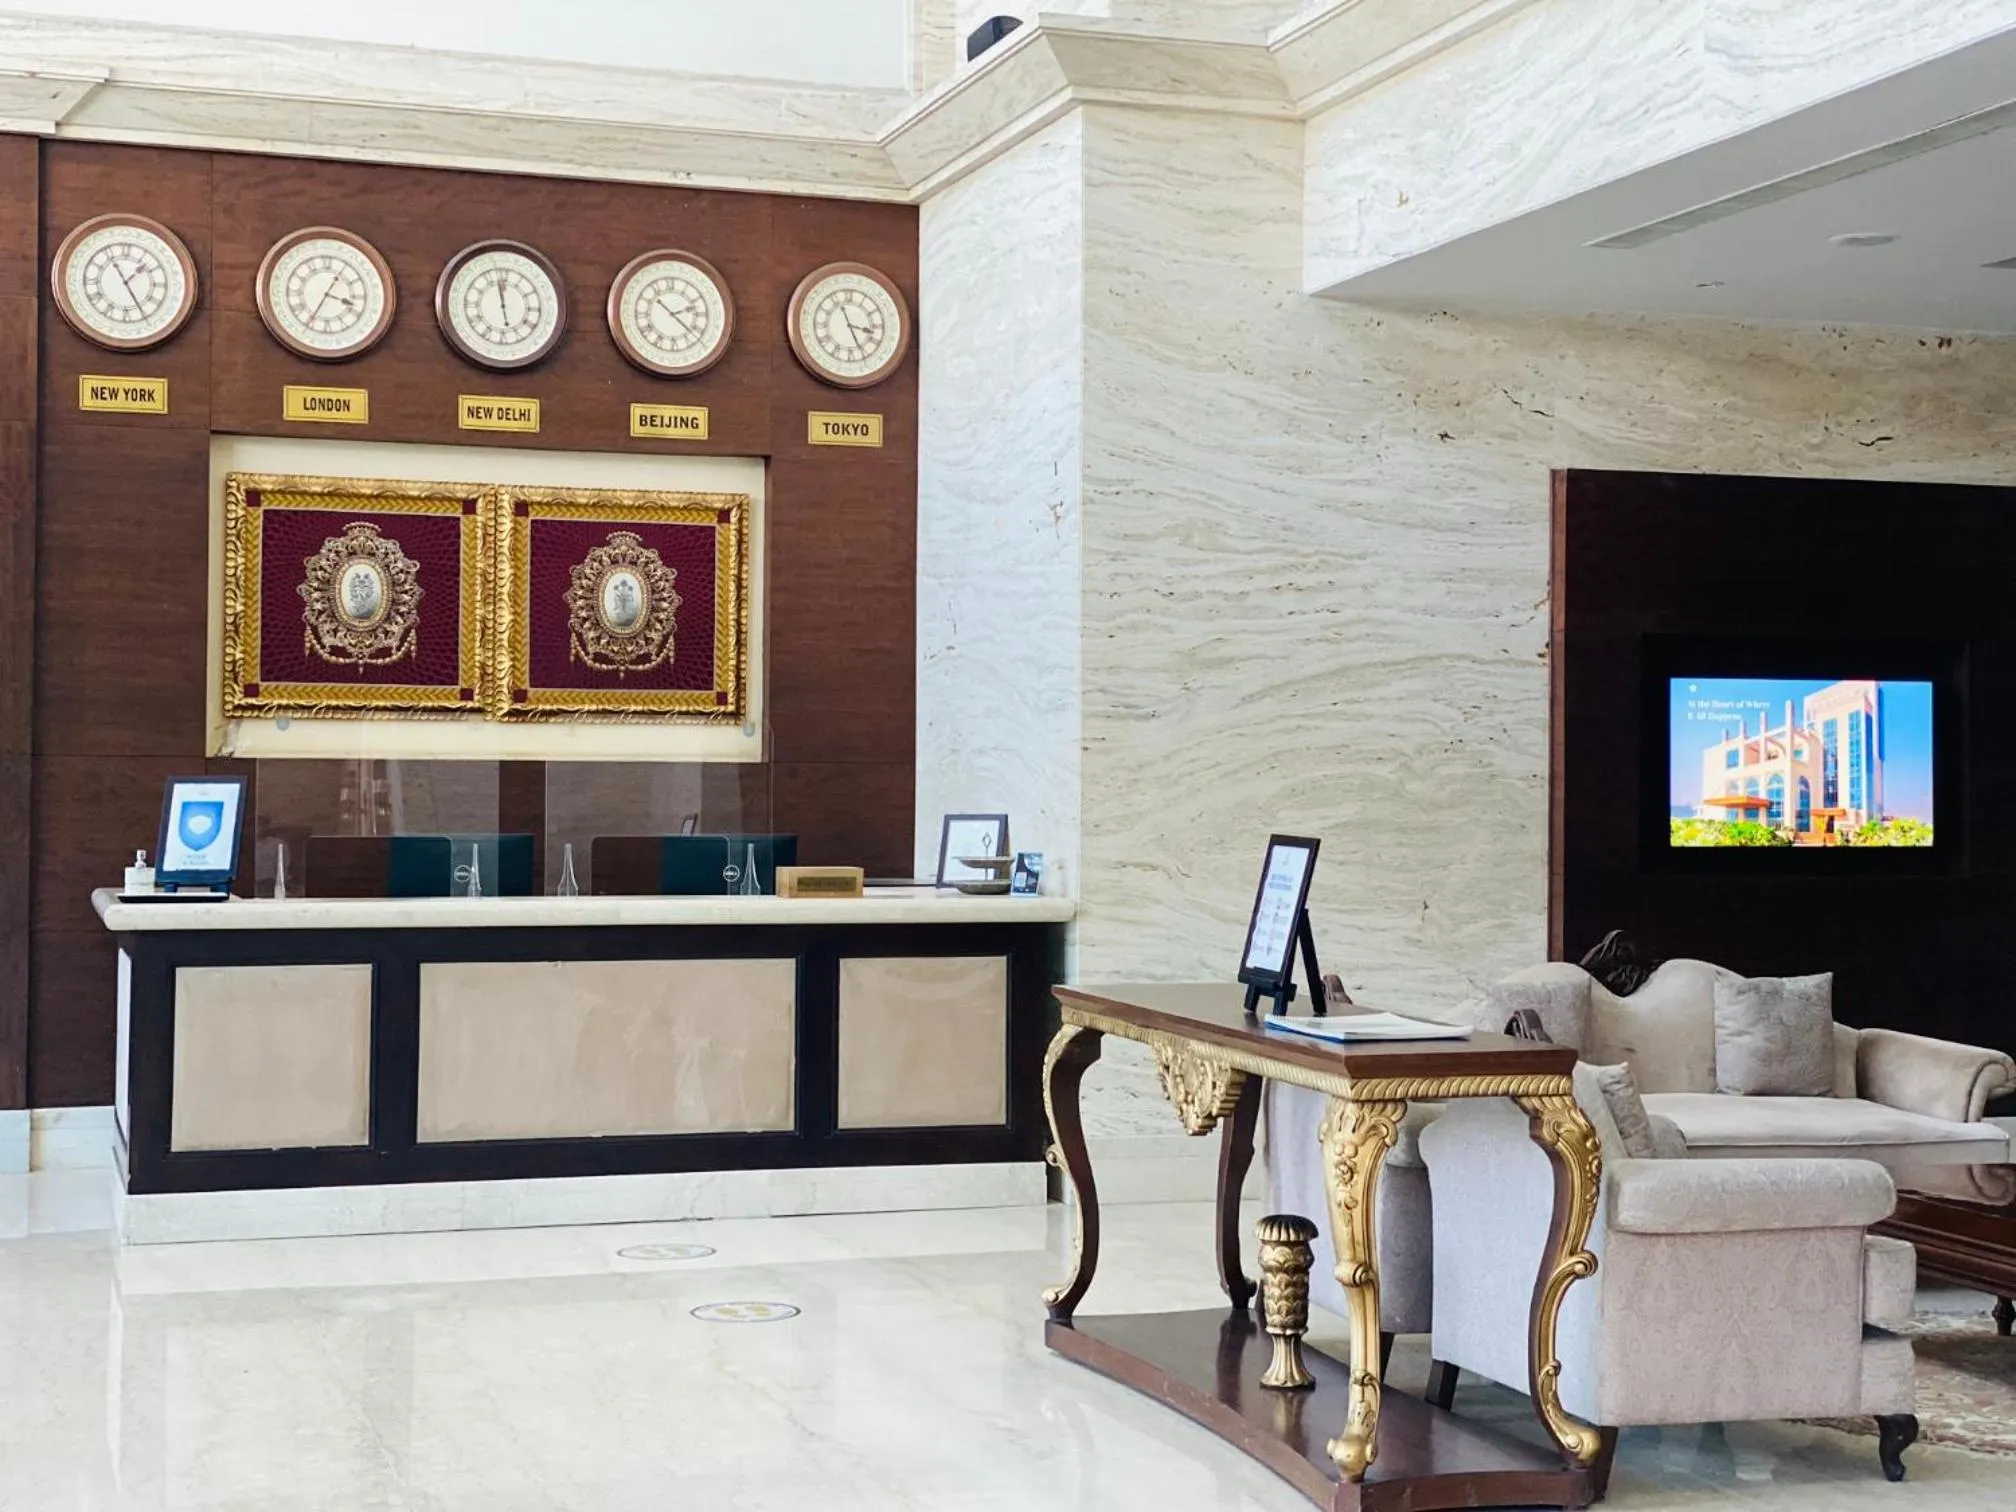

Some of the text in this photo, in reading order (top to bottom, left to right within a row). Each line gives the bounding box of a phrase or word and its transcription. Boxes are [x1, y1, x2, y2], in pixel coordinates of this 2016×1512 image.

[90, 386, 156, 402] NEW YORK
[303, 397, 350, 412] LONDON
[467, 405, 531, 422] NEW DELHI
[639, 414, 699, 430] BEIJING
[822, 422, 869, 437] TOKYO
